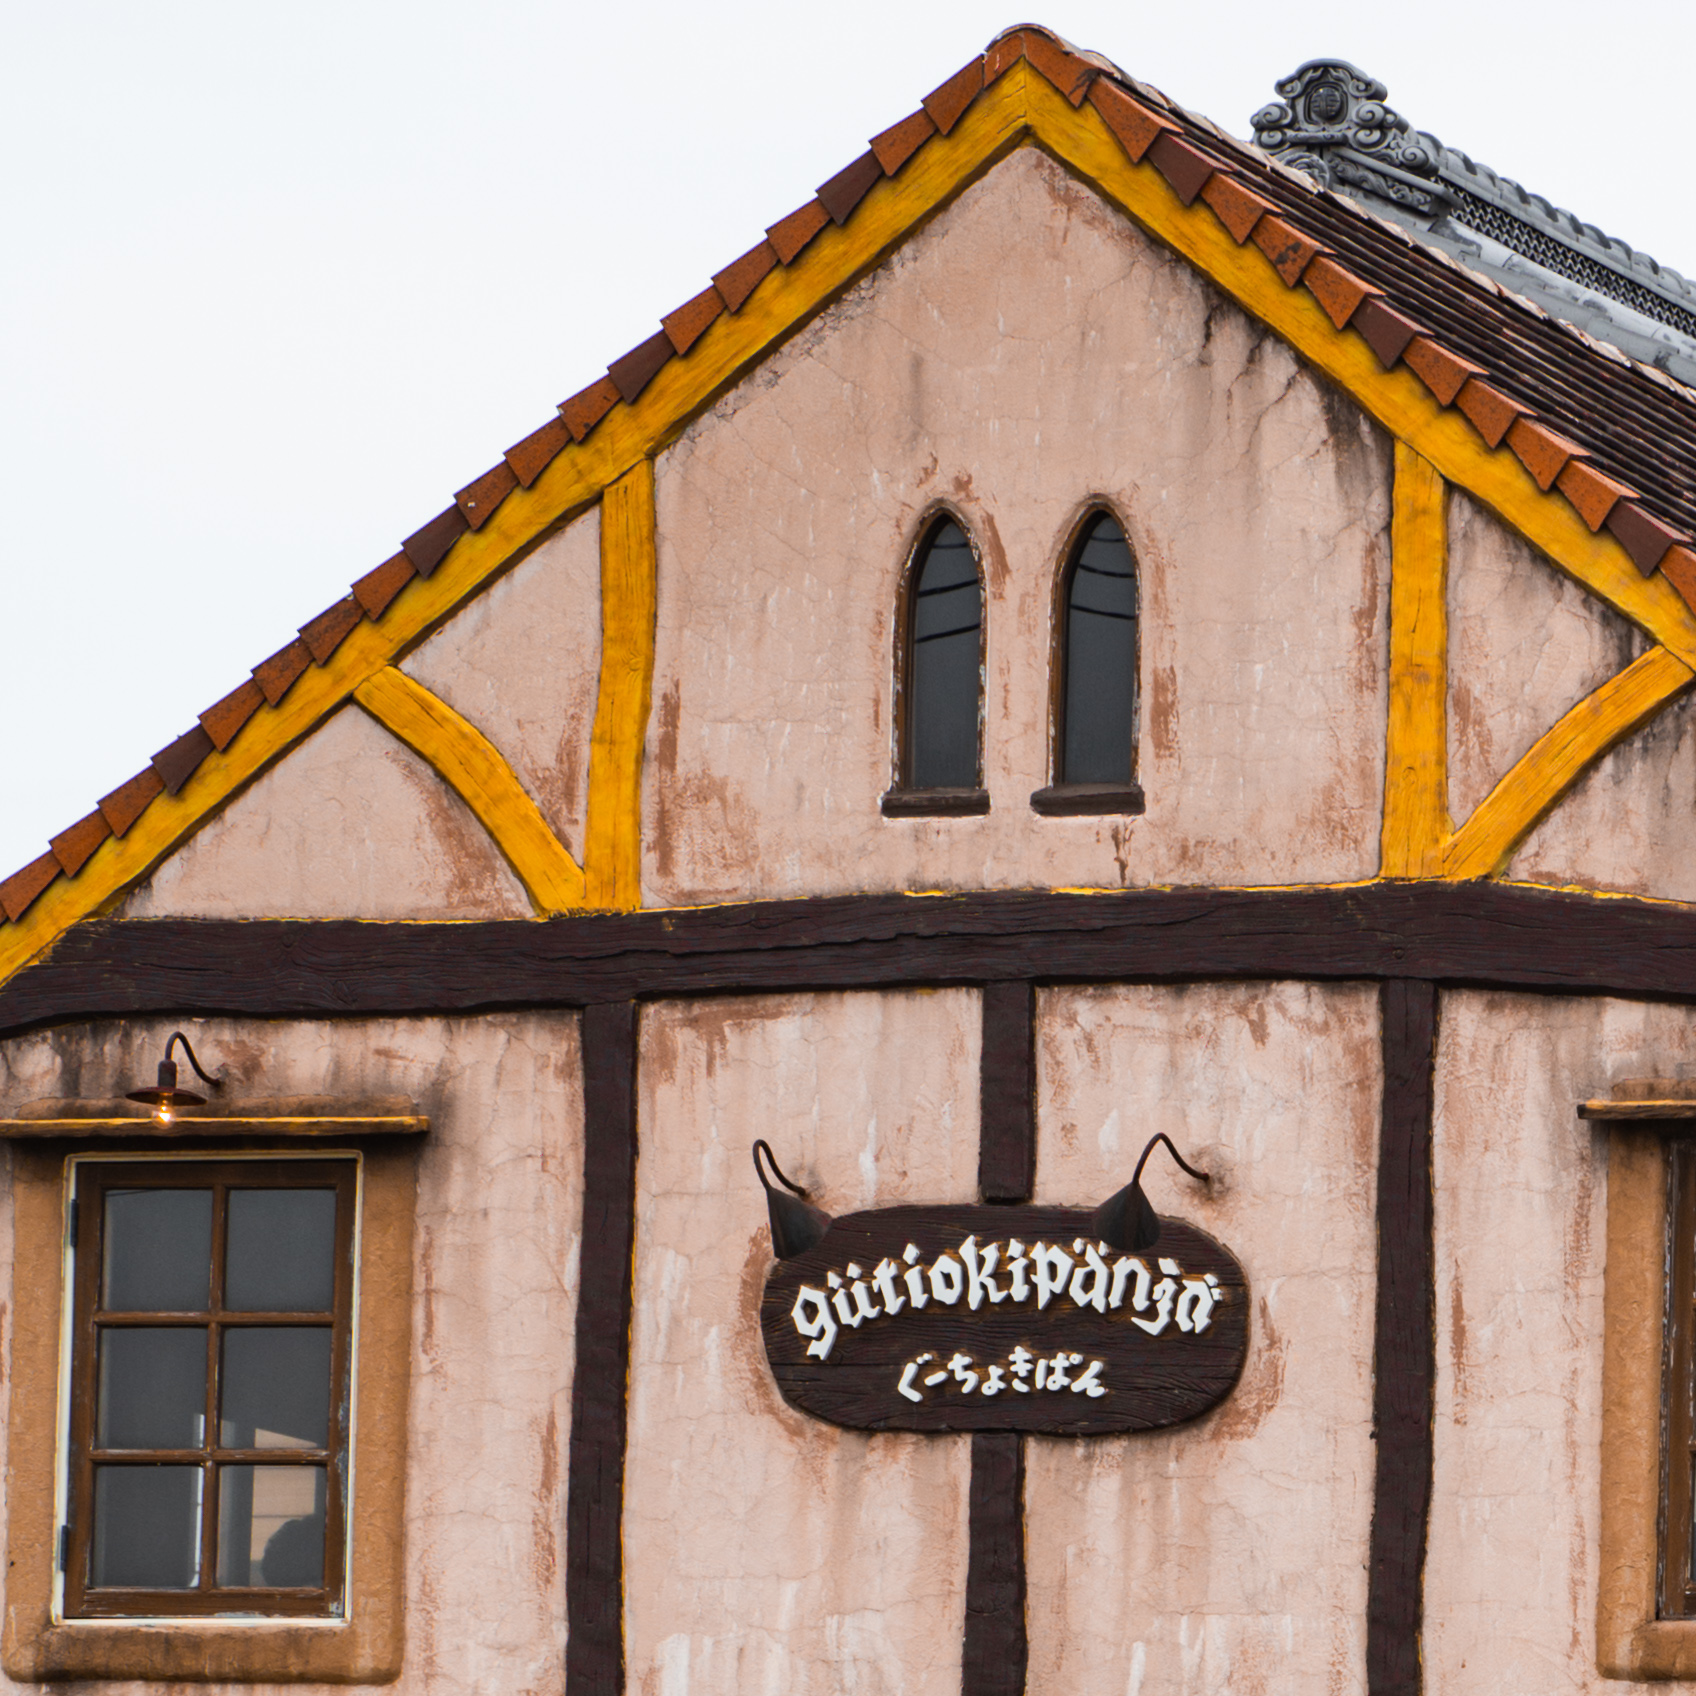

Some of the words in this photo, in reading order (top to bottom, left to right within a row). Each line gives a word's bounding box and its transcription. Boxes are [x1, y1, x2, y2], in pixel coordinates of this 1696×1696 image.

[897, 1346, 1106, 1402] ぐーちょきぱん
